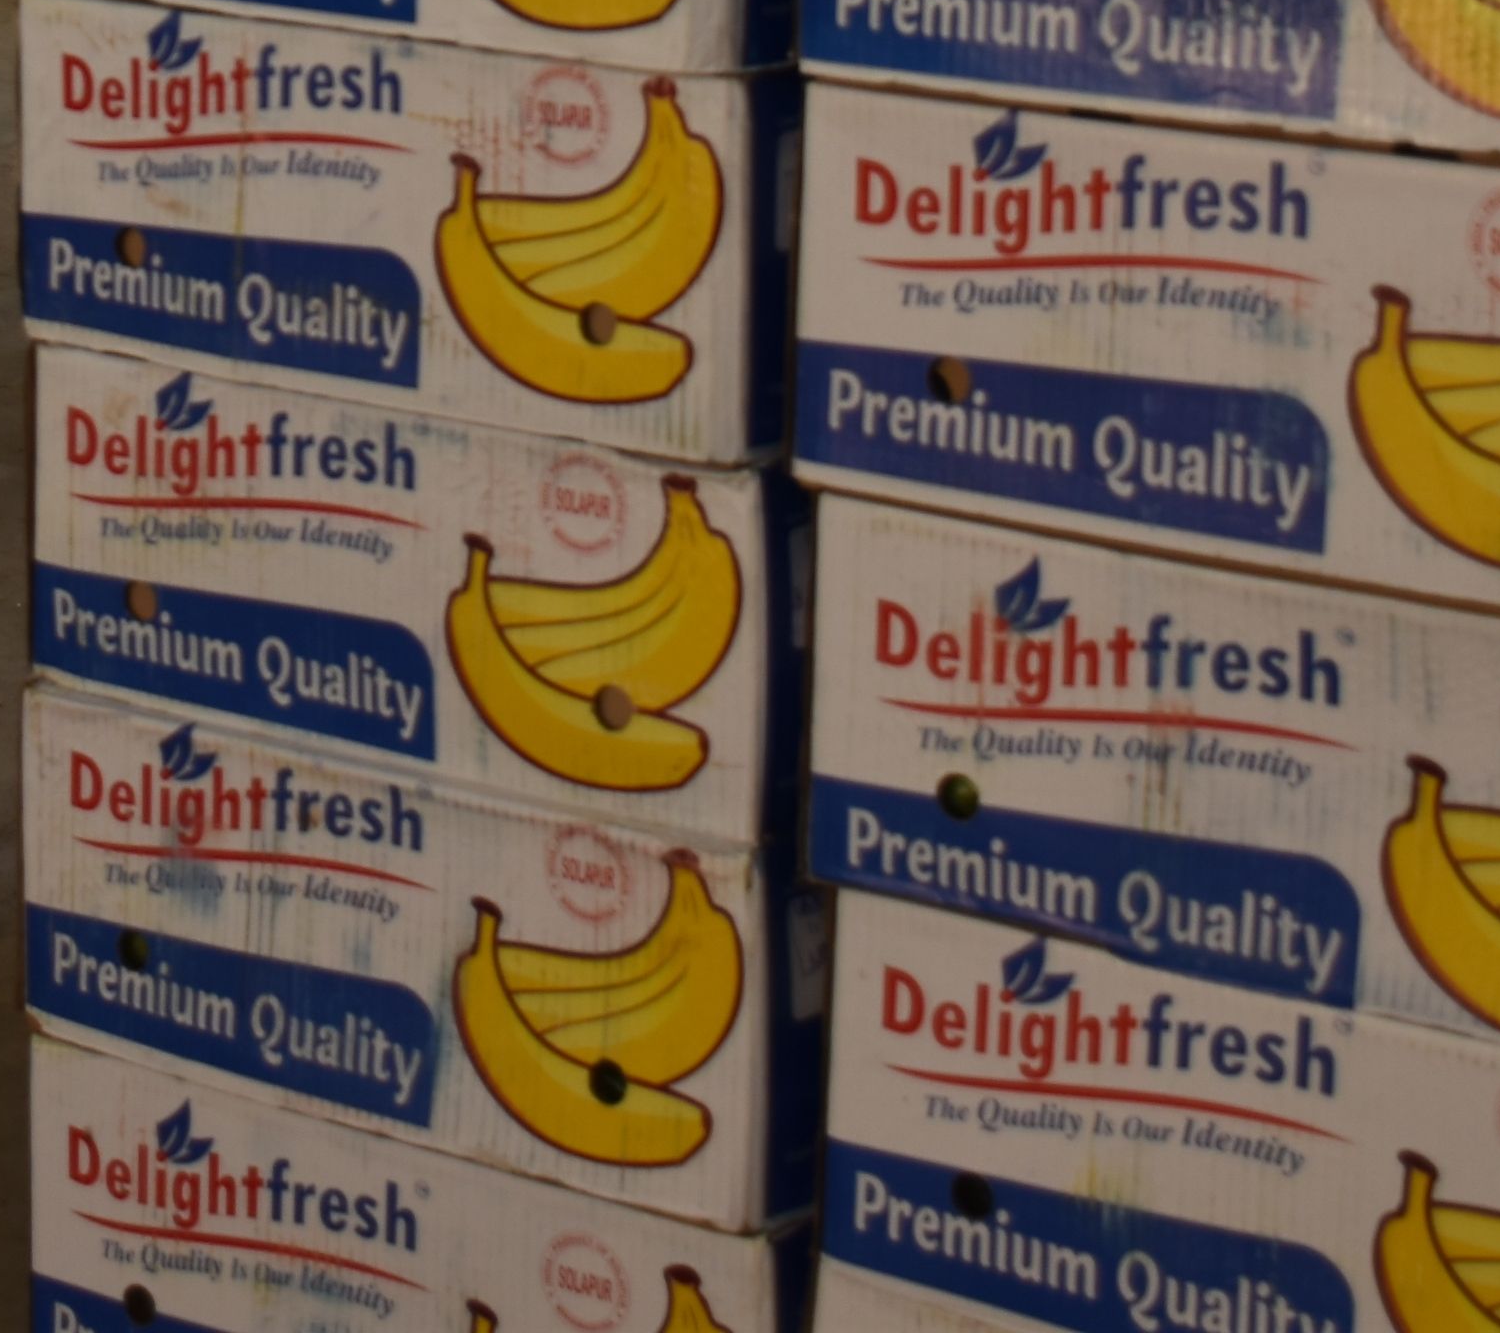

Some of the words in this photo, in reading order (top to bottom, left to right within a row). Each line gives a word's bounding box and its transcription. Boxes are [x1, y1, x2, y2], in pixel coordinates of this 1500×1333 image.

[63, 44, 399, 135] Delightfresh
[98, 161, 129, 182] The
[135, 156, 214, 186] Quality
[287, 151, 380, 186] Identity
[856, 155, 1308, 255] Delightfresh
[46, 239, 228, 321] Premium
[242, 273, 404, 369] Quality
[902, 282, 945, 306] The
[953, 279, 1059, 313] Quality
[1157, 277, 1282, 320] Identity
[61, 404, 415, 496] Delightfresh
[828, 370, 1073, 471] Premium
[1093, 416, 1310, 531] Quality
[103, 516, 136, 538] The
[142, 515, 224, 545] Quality
[300, 519, 396, 560] Identity
[49, 589, 242, 682] Premium
[256, 638, 421, 738] Quality
[873, 600, 1338, 707] Delightfresh
[70, 751, 420, 852] Delightfresh
[920, 727, 965, 752] The
[973, 727, 1083, 762] Quality
[1184, 736, 1312, 785] Identity
[105, 864, 138, 886] The
[303, 875, 399, 920] Identity
[843, 808, 1097, 922] Premium
[1117, 871, 1341, 994] Quality
[47, 934, 237, 1038] Premium
[252, 994, 420, 1105] Quality
[882, 966, 1334, 1097] Delightfresh
[927, 1096, 970, 1122] The
[978, 1099, 1084, 1139] Quality
[1182, 1118, 1307, 1173] Identity
[66, 1127, 416, 1251] Delightfresh
[853, 1172, 1097, 1299] Premium
[102, 1239, 135, 1263] The
[141, 1244, 223, 1281] Quality
[300, 1265, 396, 1317] Identity
